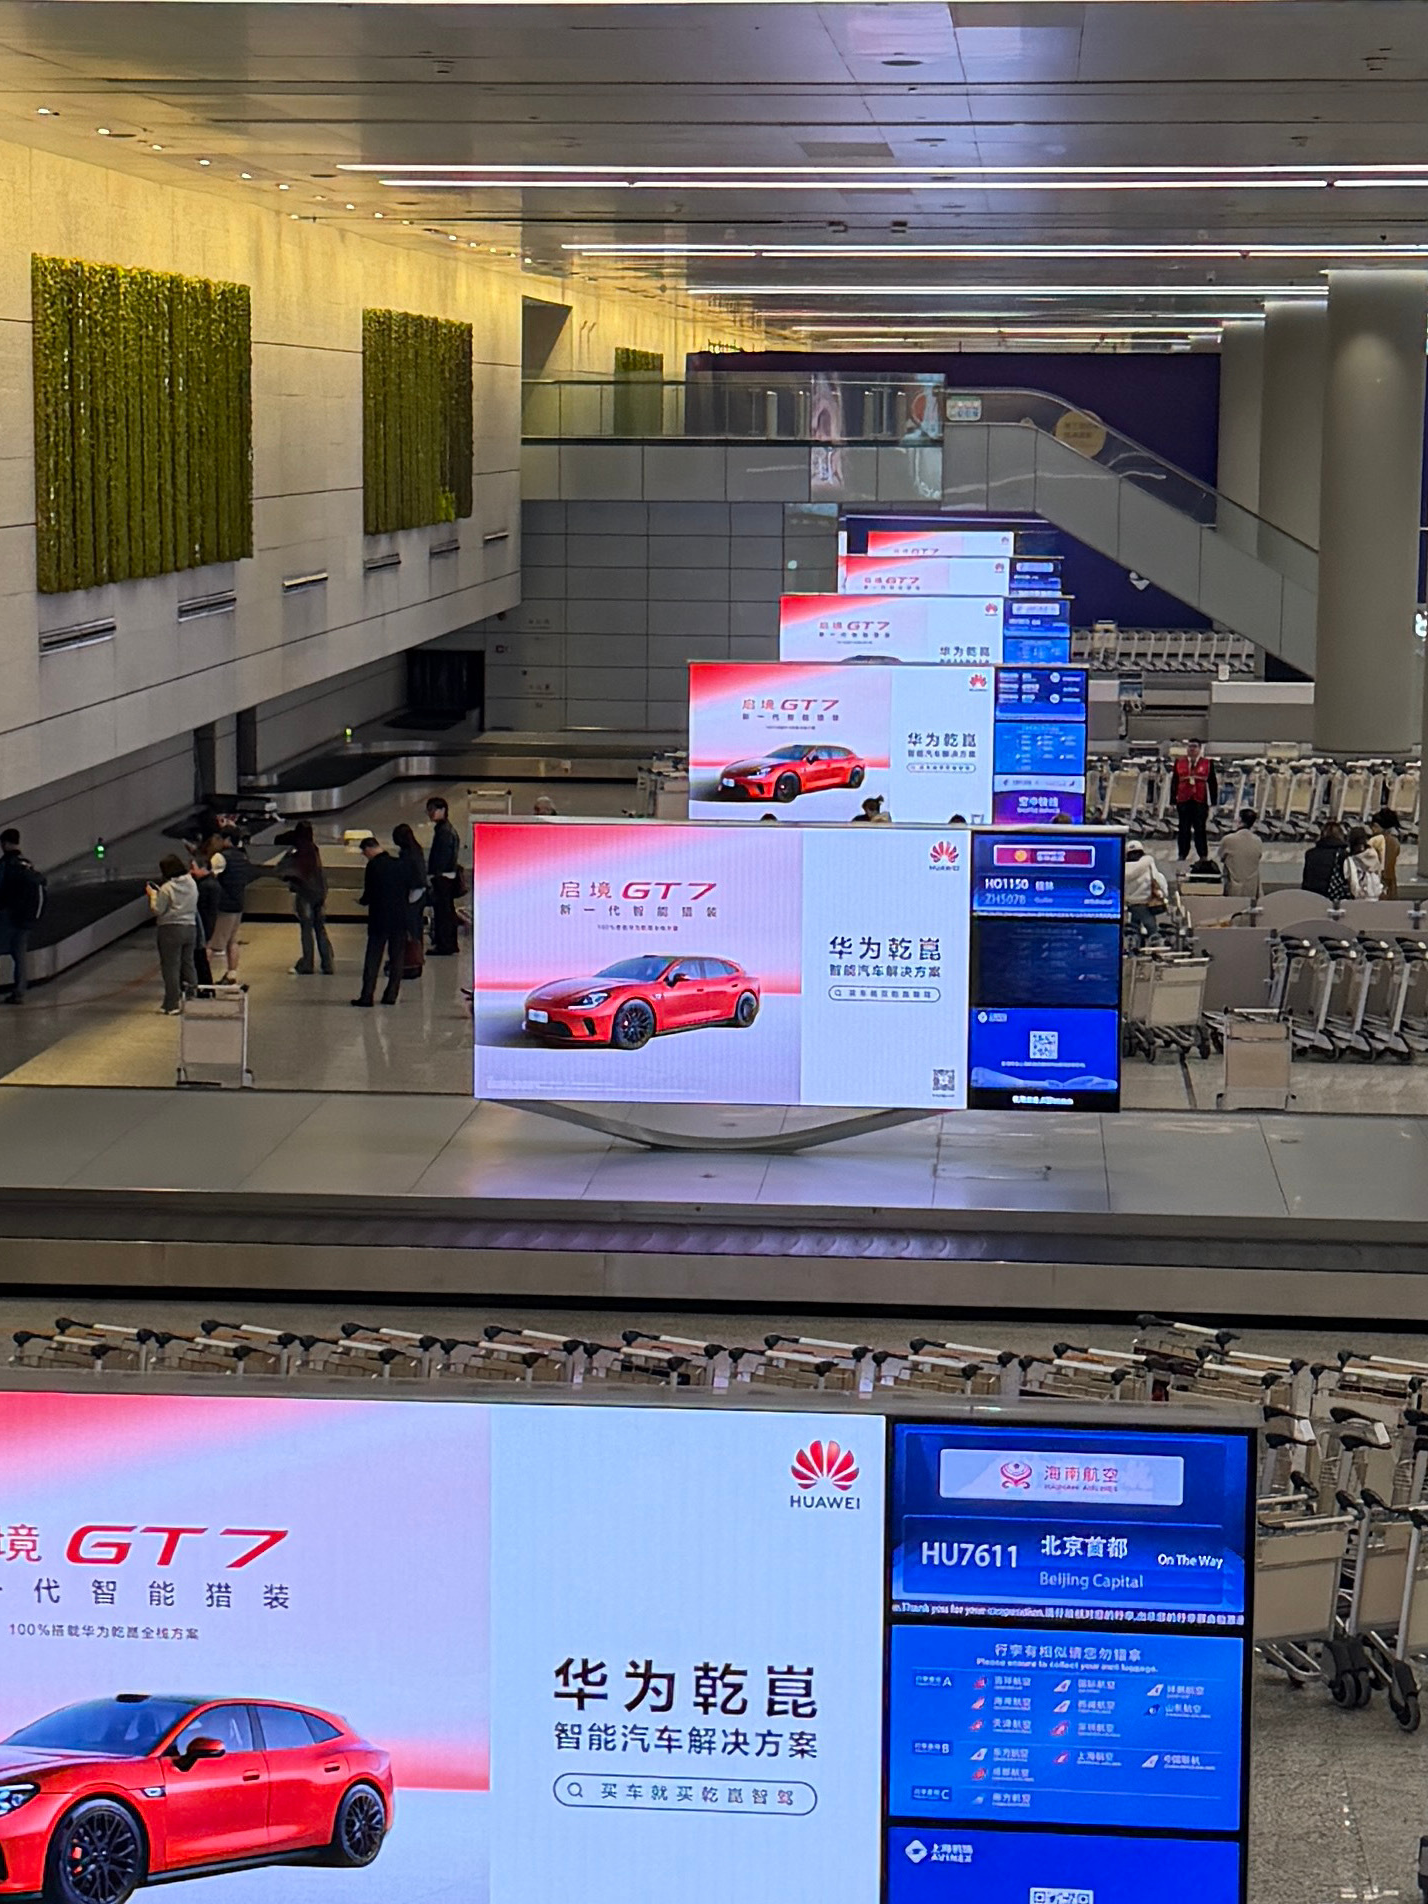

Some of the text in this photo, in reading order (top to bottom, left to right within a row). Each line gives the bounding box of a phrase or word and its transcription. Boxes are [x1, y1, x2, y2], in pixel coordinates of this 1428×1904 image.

[780, 699, 839, 711] GT7
[560, 882, 717, 900] 启境 GT7
[829, 936, 941, 960] 华为乾崑
[1044, 1465, 1118, 1483] 海南航空
[790, 1495, 860, 1509] HUAWEI
[66, 1525, 289, 1568] GT7
[921, 1542, 1018, 1568] HU7611
[1041, 1535, 1128, 1559] 北京首都
[1158, 1554, 1223, 1569] On The Way
[1040, 1572, 1143, 1590] Beijing Capital
[553, 1657, 817, 1719] 华为乾崑
[554, 1722, 817, 1759] 智能汽车解决方案
[601, 1783, 793, 1805] 买车就买乾崑智驾
